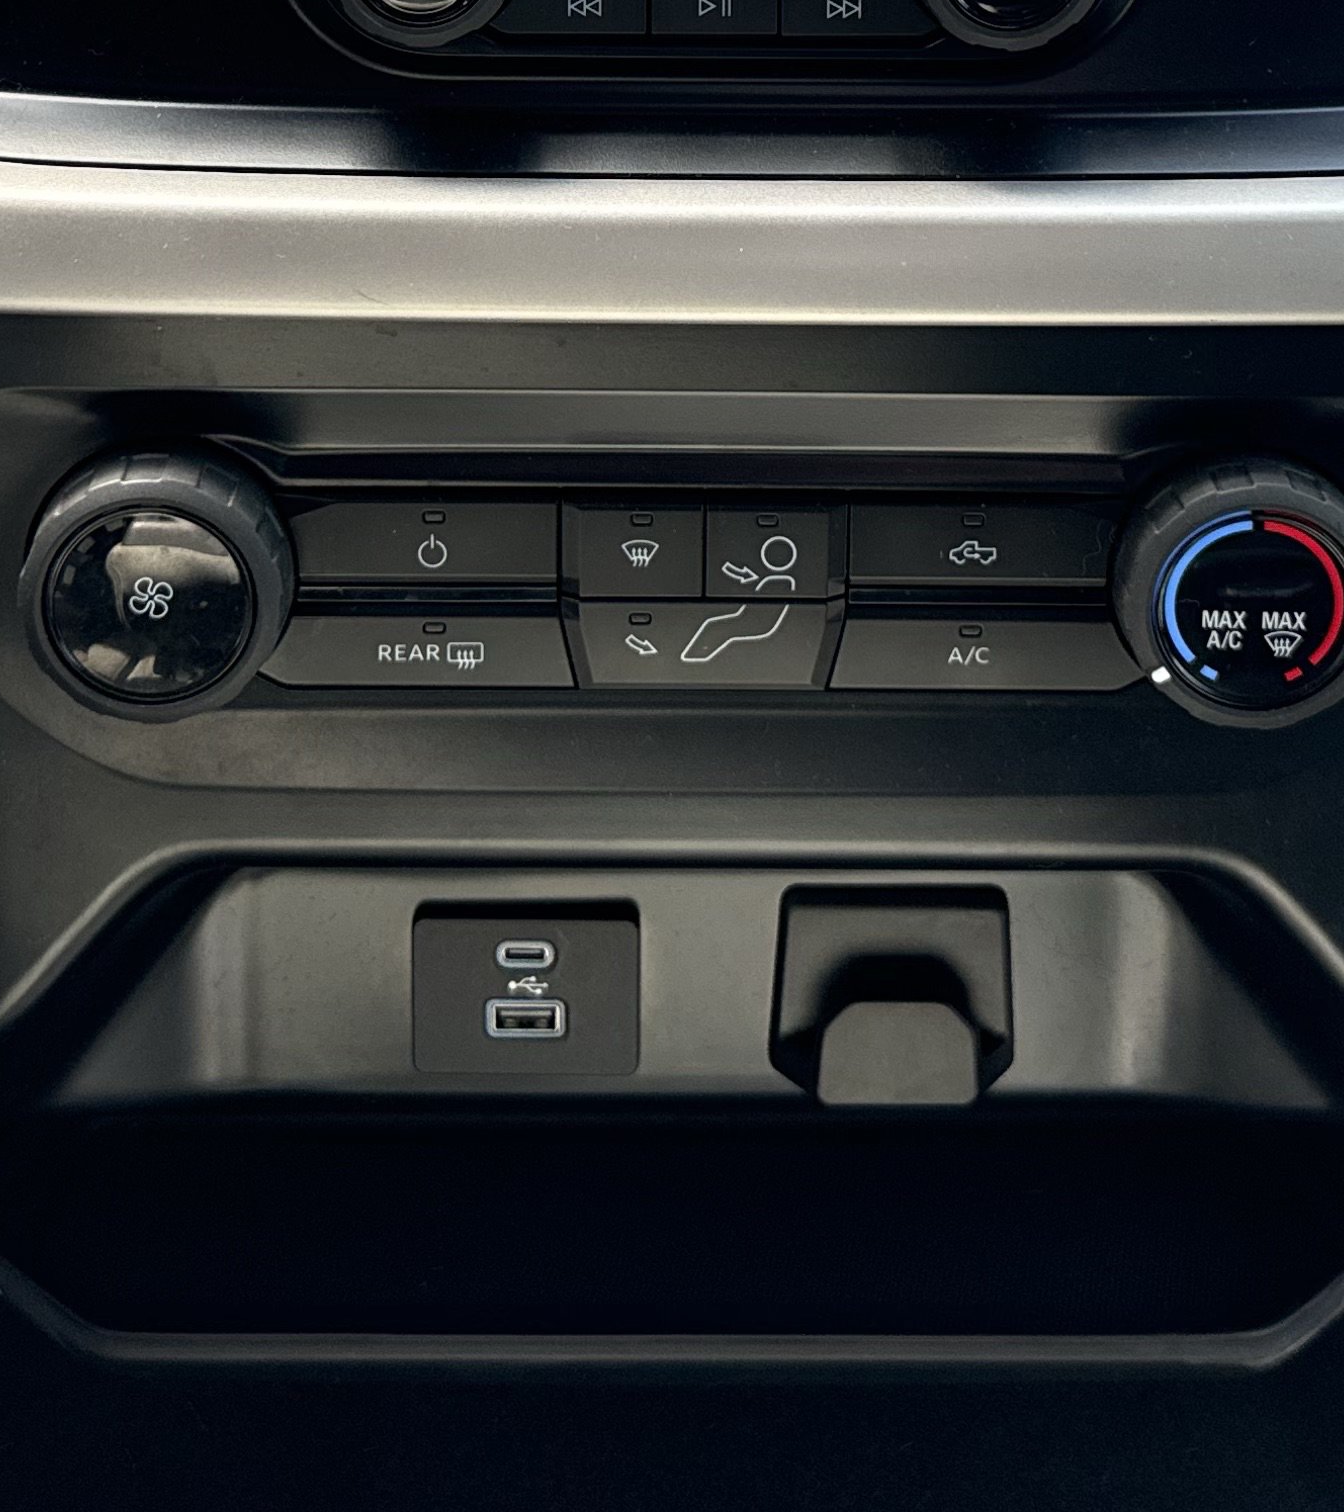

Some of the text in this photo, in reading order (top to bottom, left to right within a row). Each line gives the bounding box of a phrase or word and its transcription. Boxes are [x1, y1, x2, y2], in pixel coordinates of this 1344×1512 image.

[1201, 610, 1247, 630] MAX
[1261, 611, 1306, 631] MAX
[1205, 630, 1243, 651] A/C
[376, 642, 441, 663] REAR
[947, 646, 989, 665] A/C
